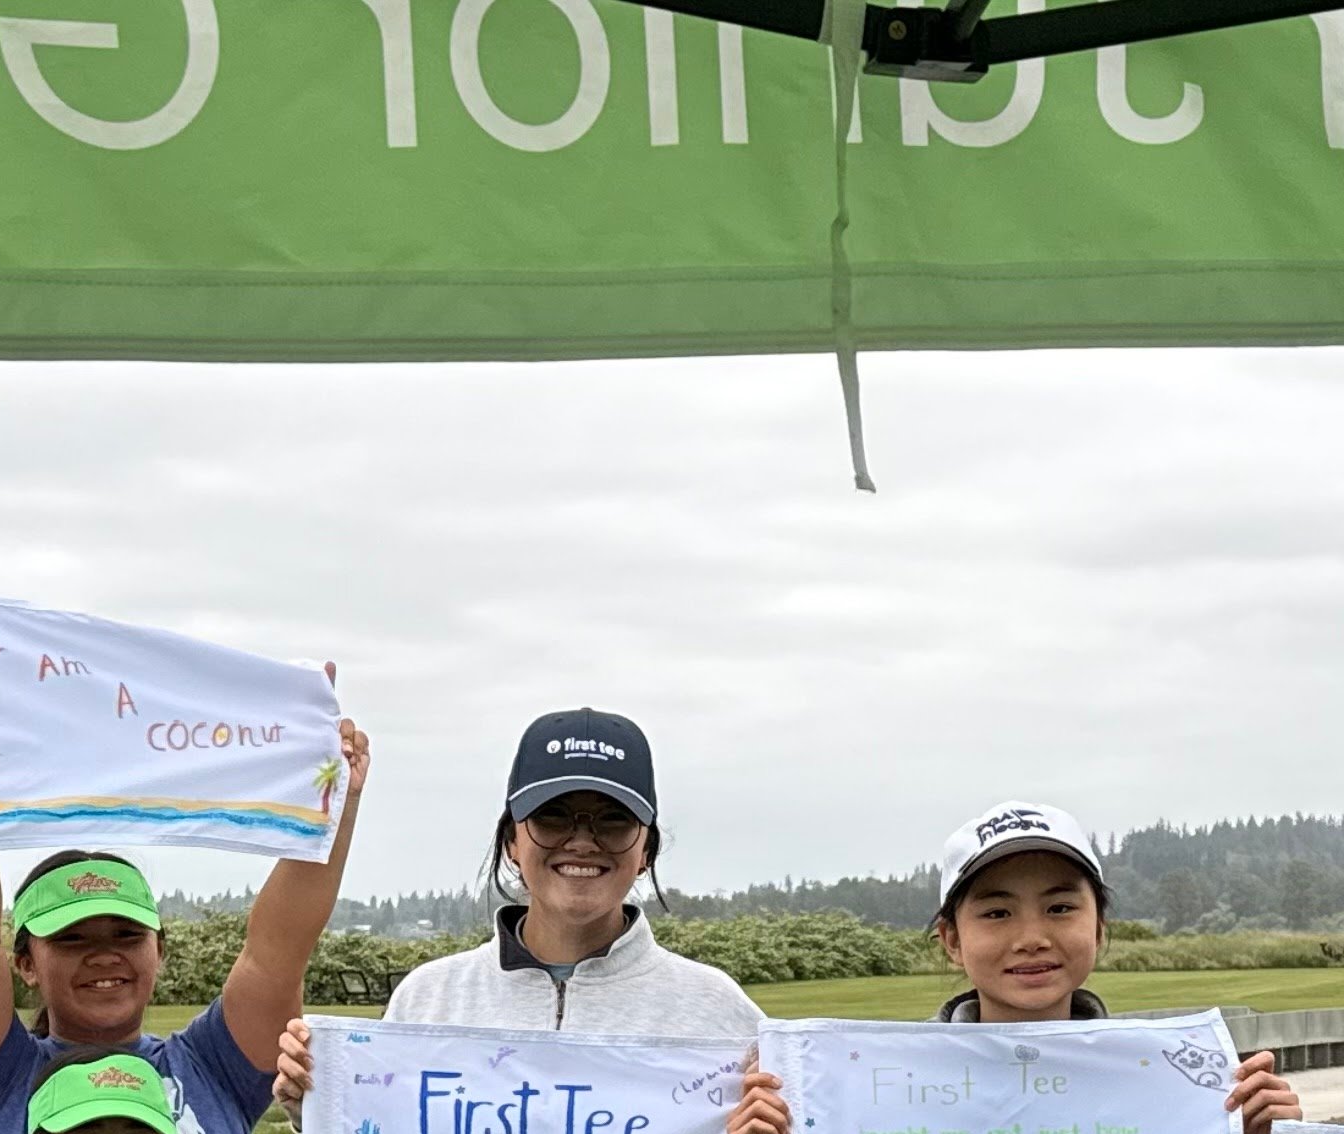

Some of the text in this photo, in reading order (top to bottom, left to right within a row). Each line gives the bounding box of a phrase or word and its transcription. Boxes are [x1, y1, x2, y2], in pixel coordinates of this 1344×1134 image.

[117, 682, 139, 719] A
[871, 1060, 1069, 1106] First Tee
